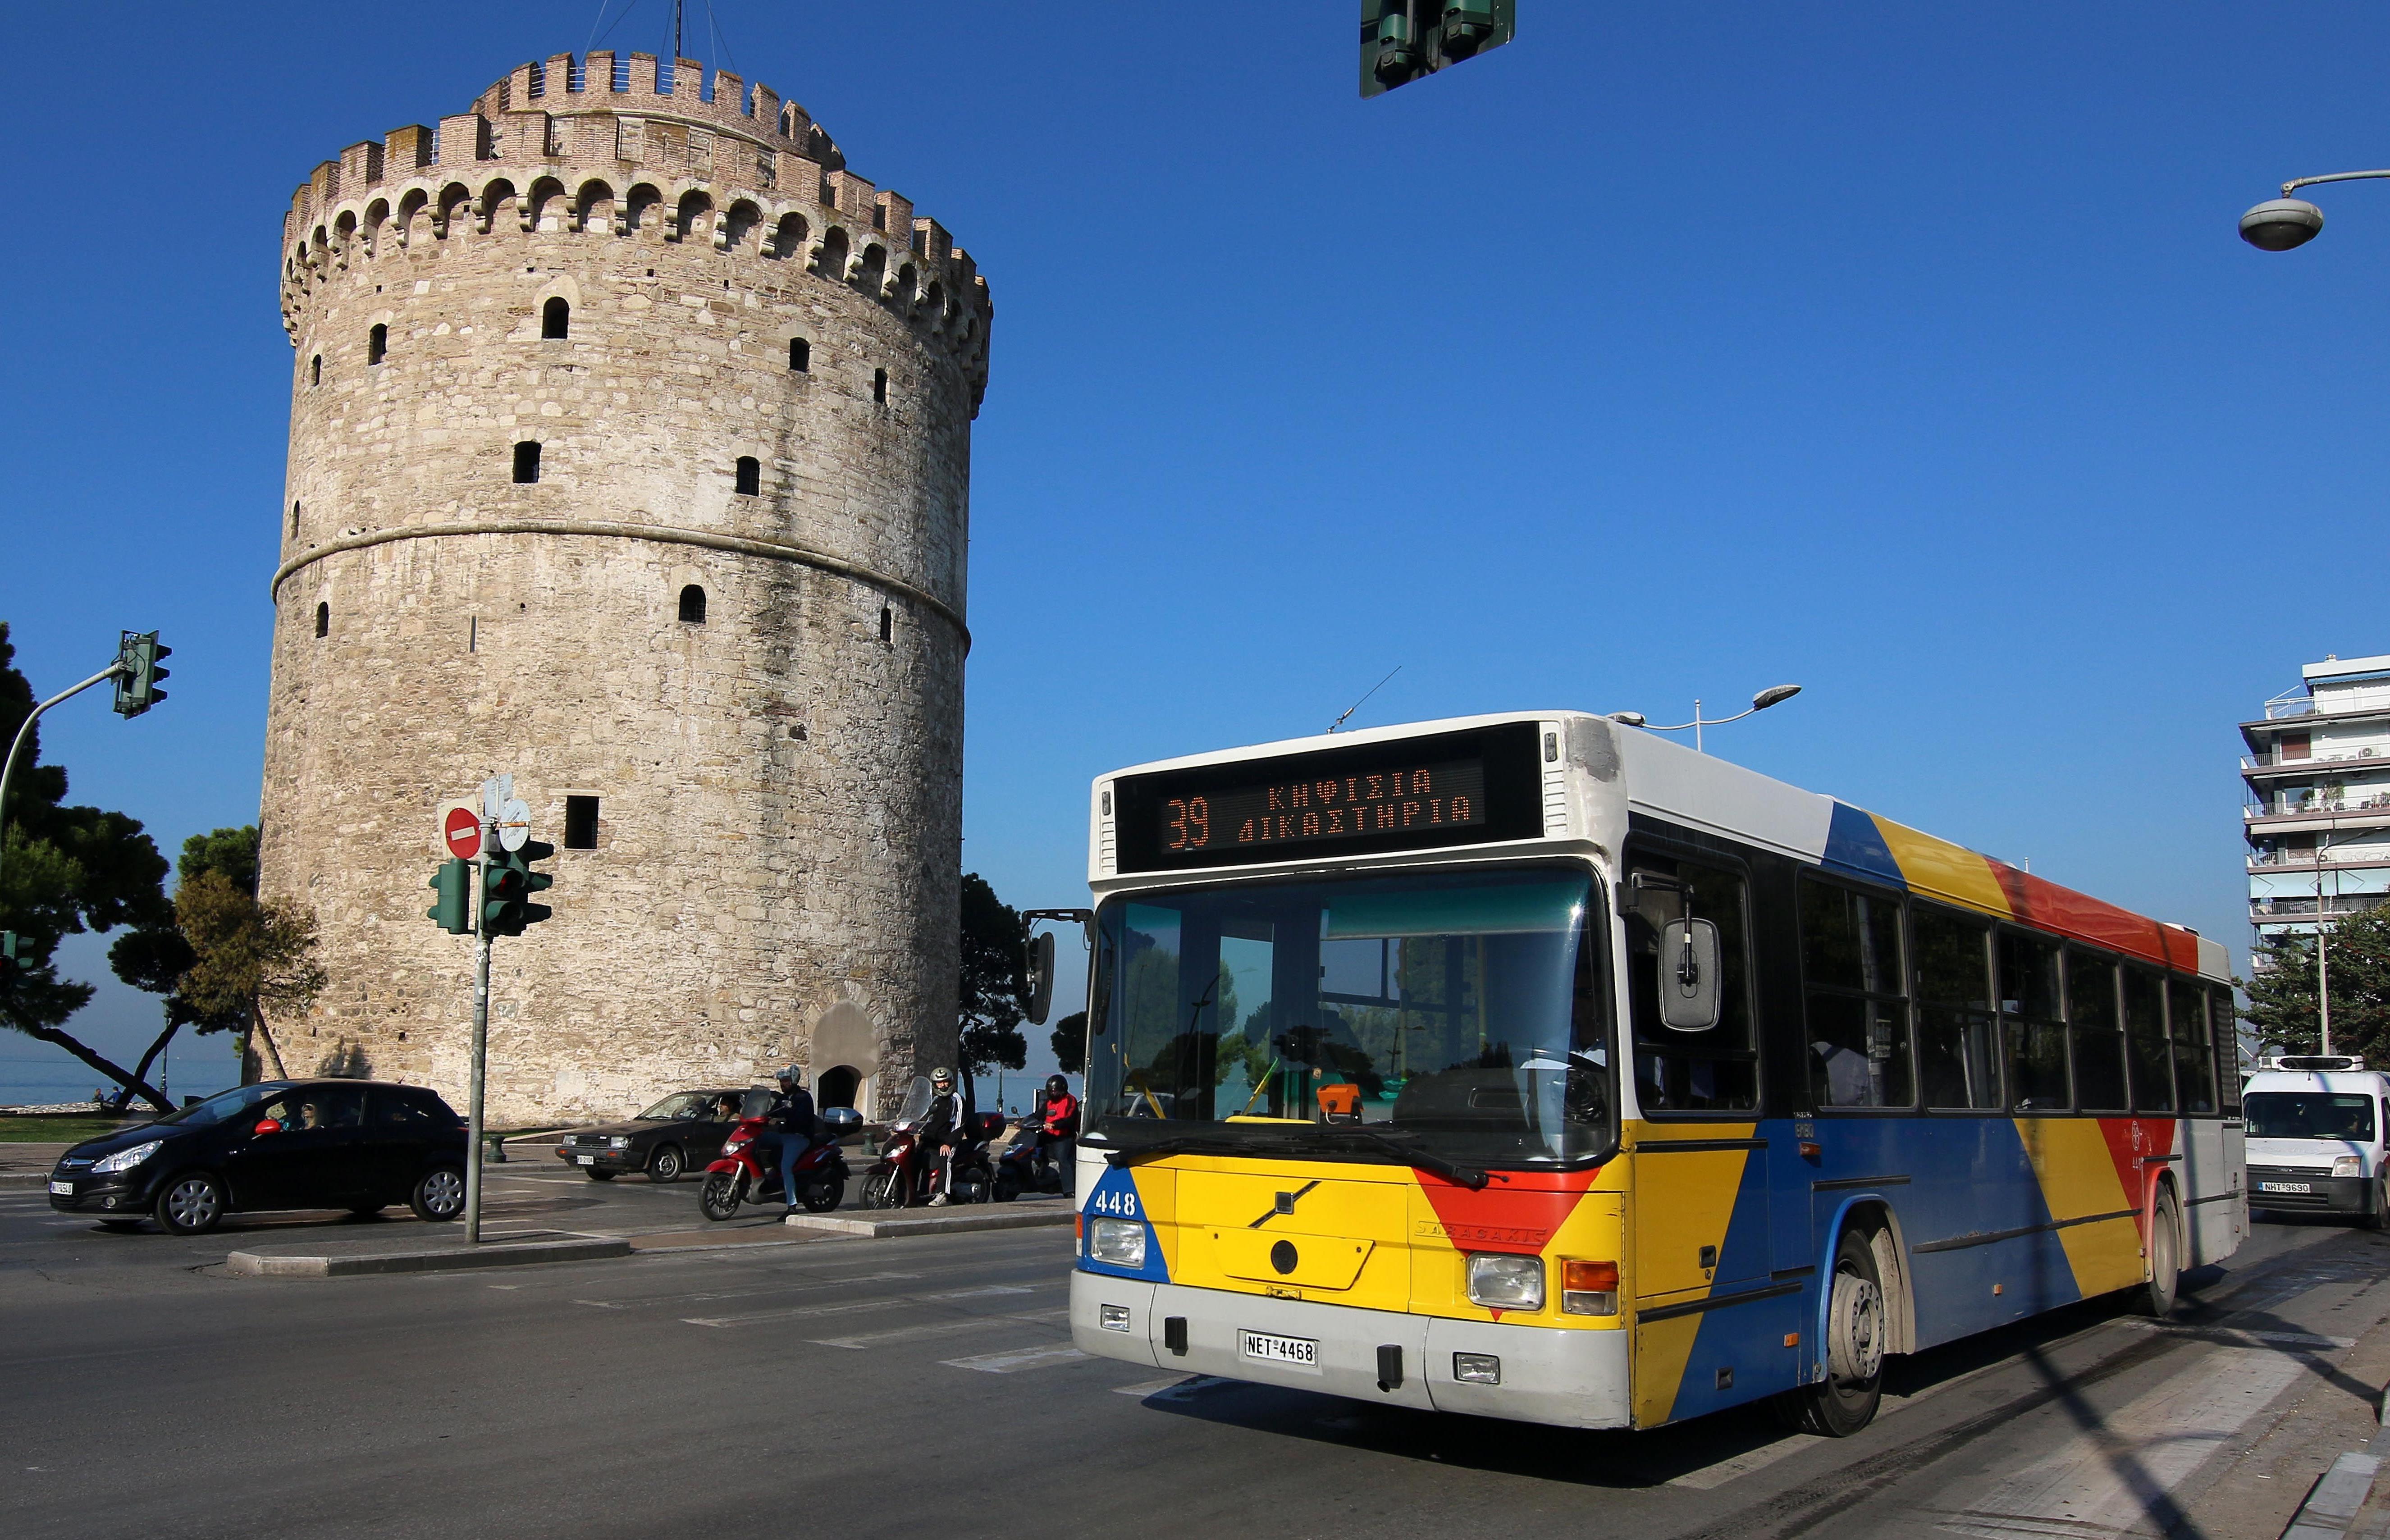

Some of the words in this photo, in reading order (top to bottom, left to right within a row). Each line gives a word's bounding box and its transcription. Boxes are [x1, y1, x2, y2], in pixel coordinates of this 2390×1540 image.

[1168, 796, 1208, 848] 39
[1238, 796, 1470, 842] ΔΙΚΑΣΤΗΡΙΑ
[1096, 1190, 1135, 1216] 448
